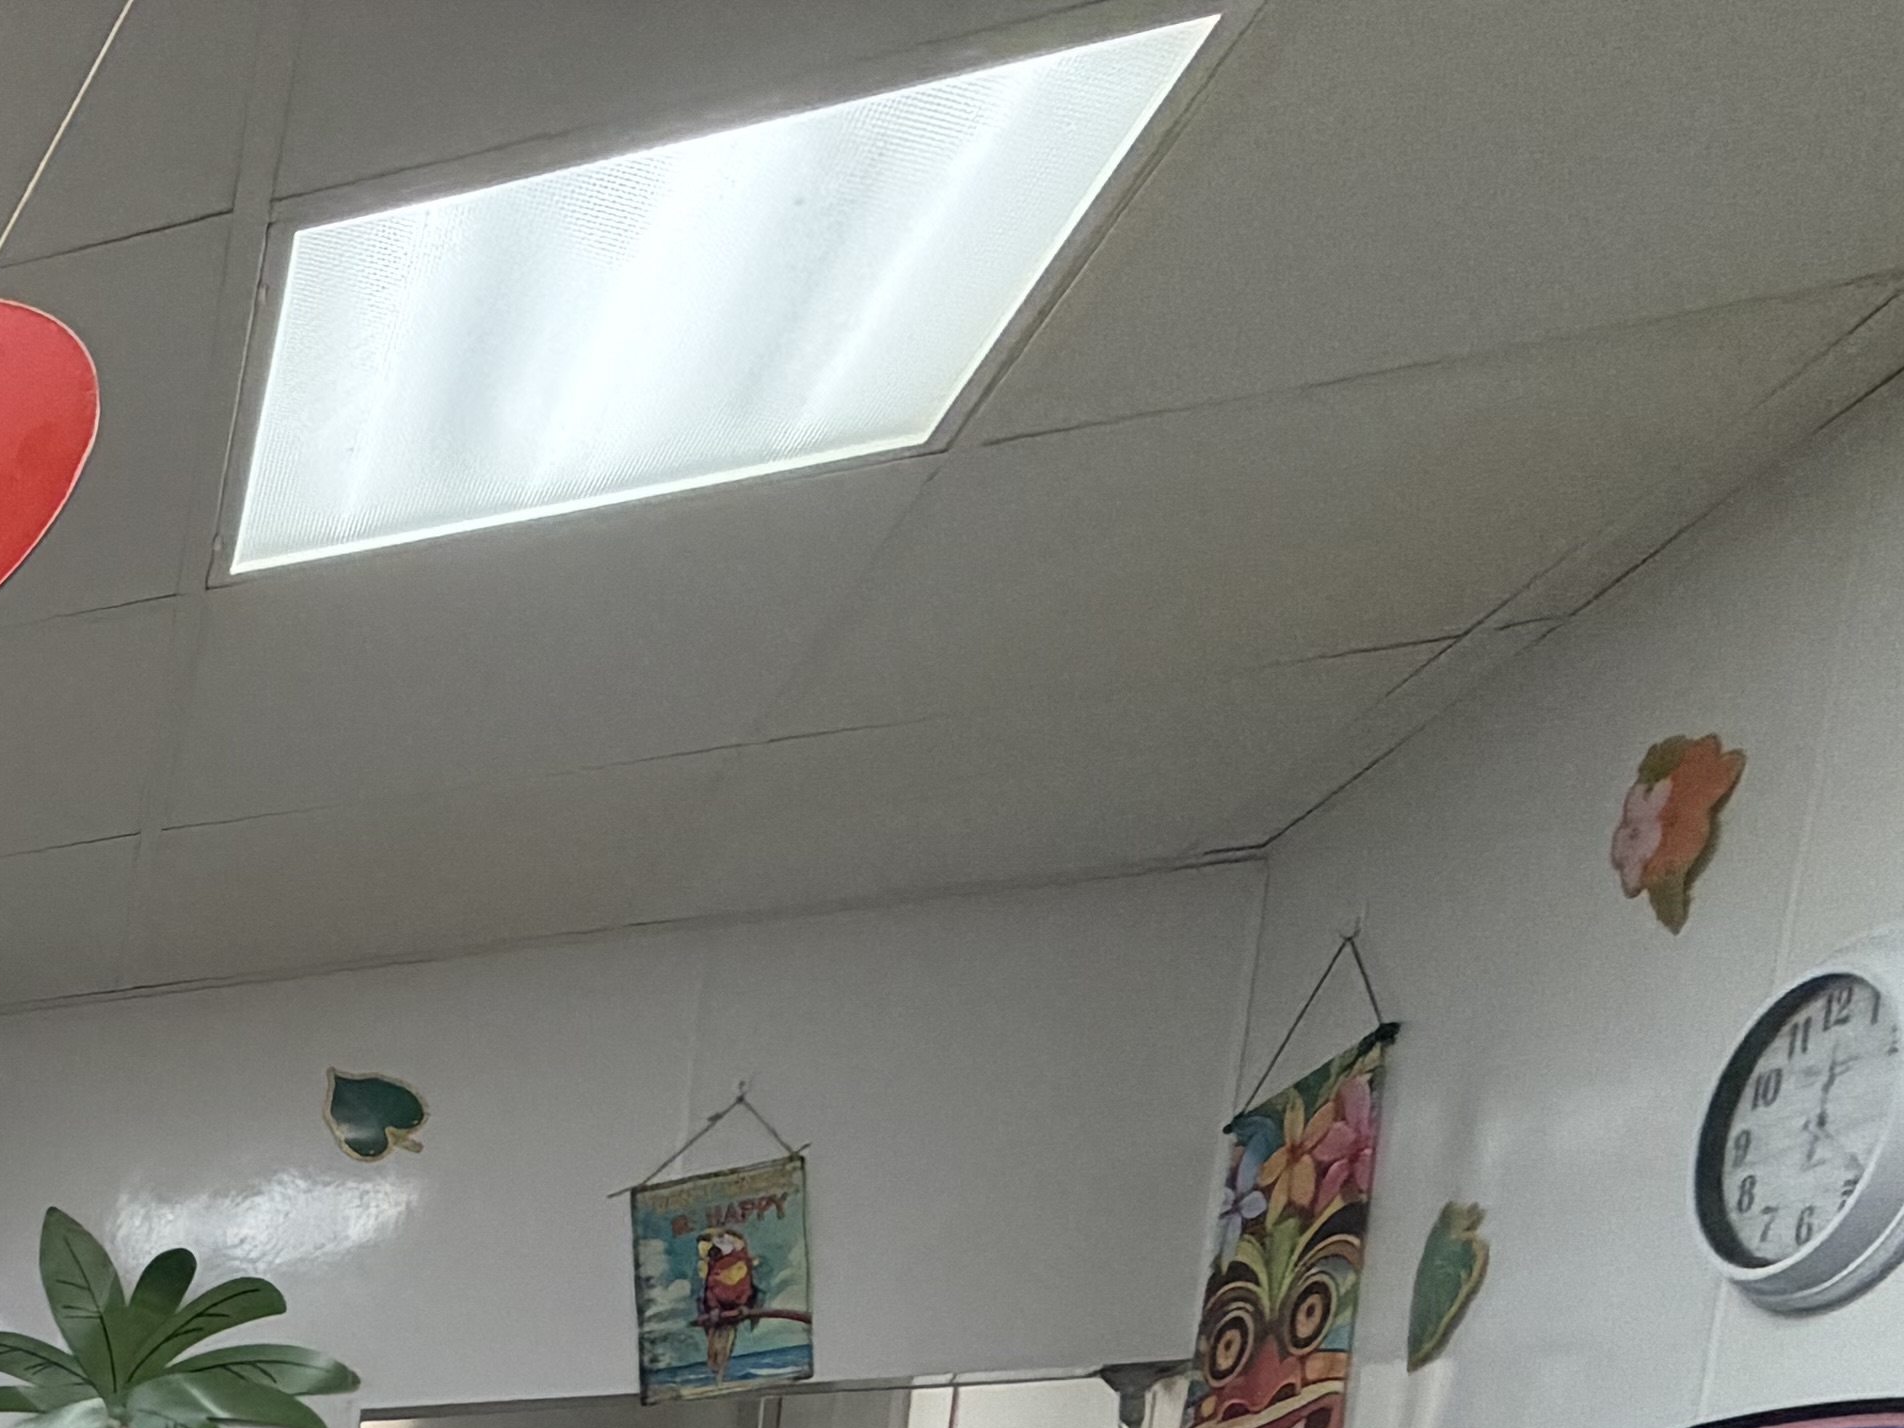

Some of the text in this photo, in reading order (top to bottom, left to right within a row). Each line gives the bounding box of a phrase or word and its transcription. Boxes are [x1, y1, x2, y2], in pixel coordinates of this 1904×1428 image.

[1822, 987, 1853, 1031] 12
[1788, 1016, 1812, 1060] 11
[1752, 1068, 1783, 1111] 10
[1732, 1129, 1752, 1168] 9
[1737, 1175, 1757, 1213] 8
[1760, 1206, 1778, 1242] 7
[1795, 1205, 1815, 1246] 6
